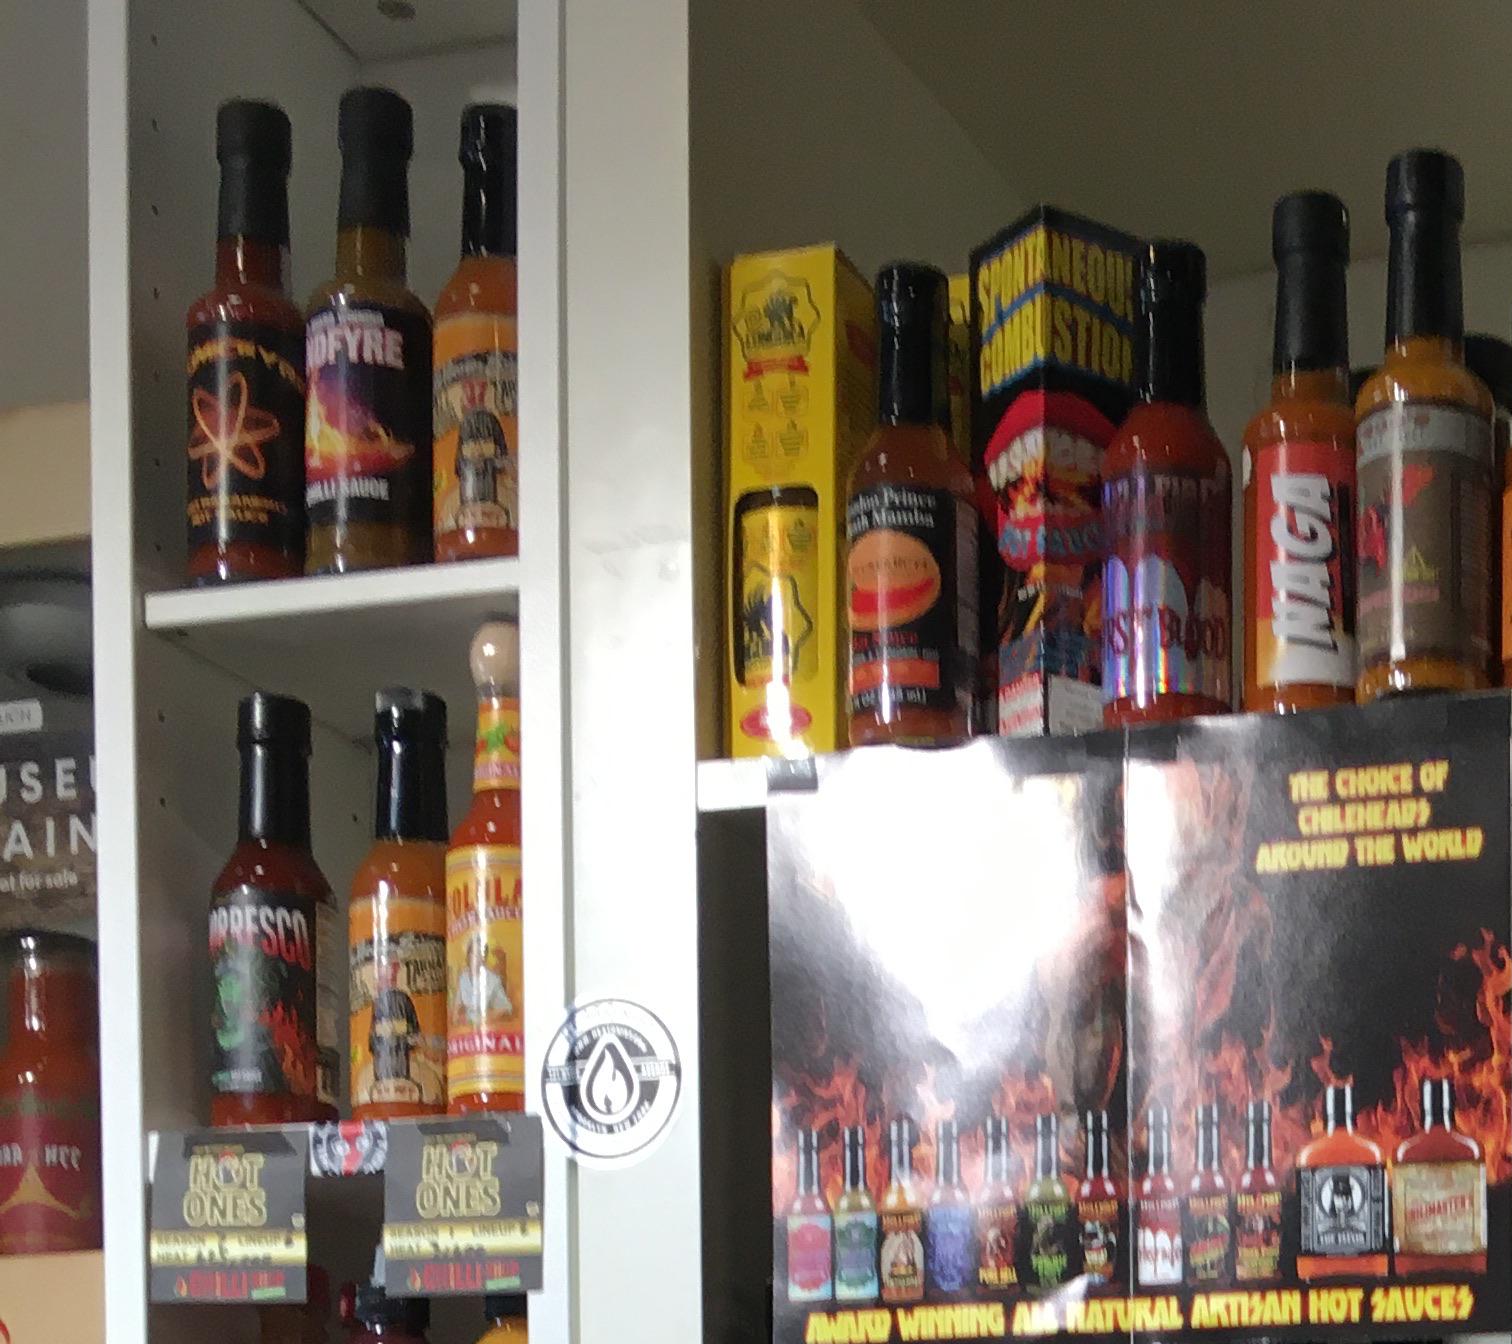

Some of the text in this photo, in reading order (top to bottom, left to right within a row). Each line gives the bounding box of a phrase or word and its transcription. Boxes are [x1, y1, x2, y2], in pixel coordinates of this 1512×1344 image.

[1289, 761, 1449, 802] THE CHOICE OF
[1255, 829, 1482, 873] AROUND THE WORLD
[187, 1152, 264, 1190] HOT
[421, 1141, 502, 1180] HOT
[183, 1189, 267, 1228] ONES
[415, 1177, 501, 1218] ONES
[898, 1304, 1005, 1339] WINNING
[1191, 1292, 1301, 1328] ARTISAN
[1308, 1289, 1361, 1323] HOT
[1370, 1286, 1474, 1321] SAUCES
